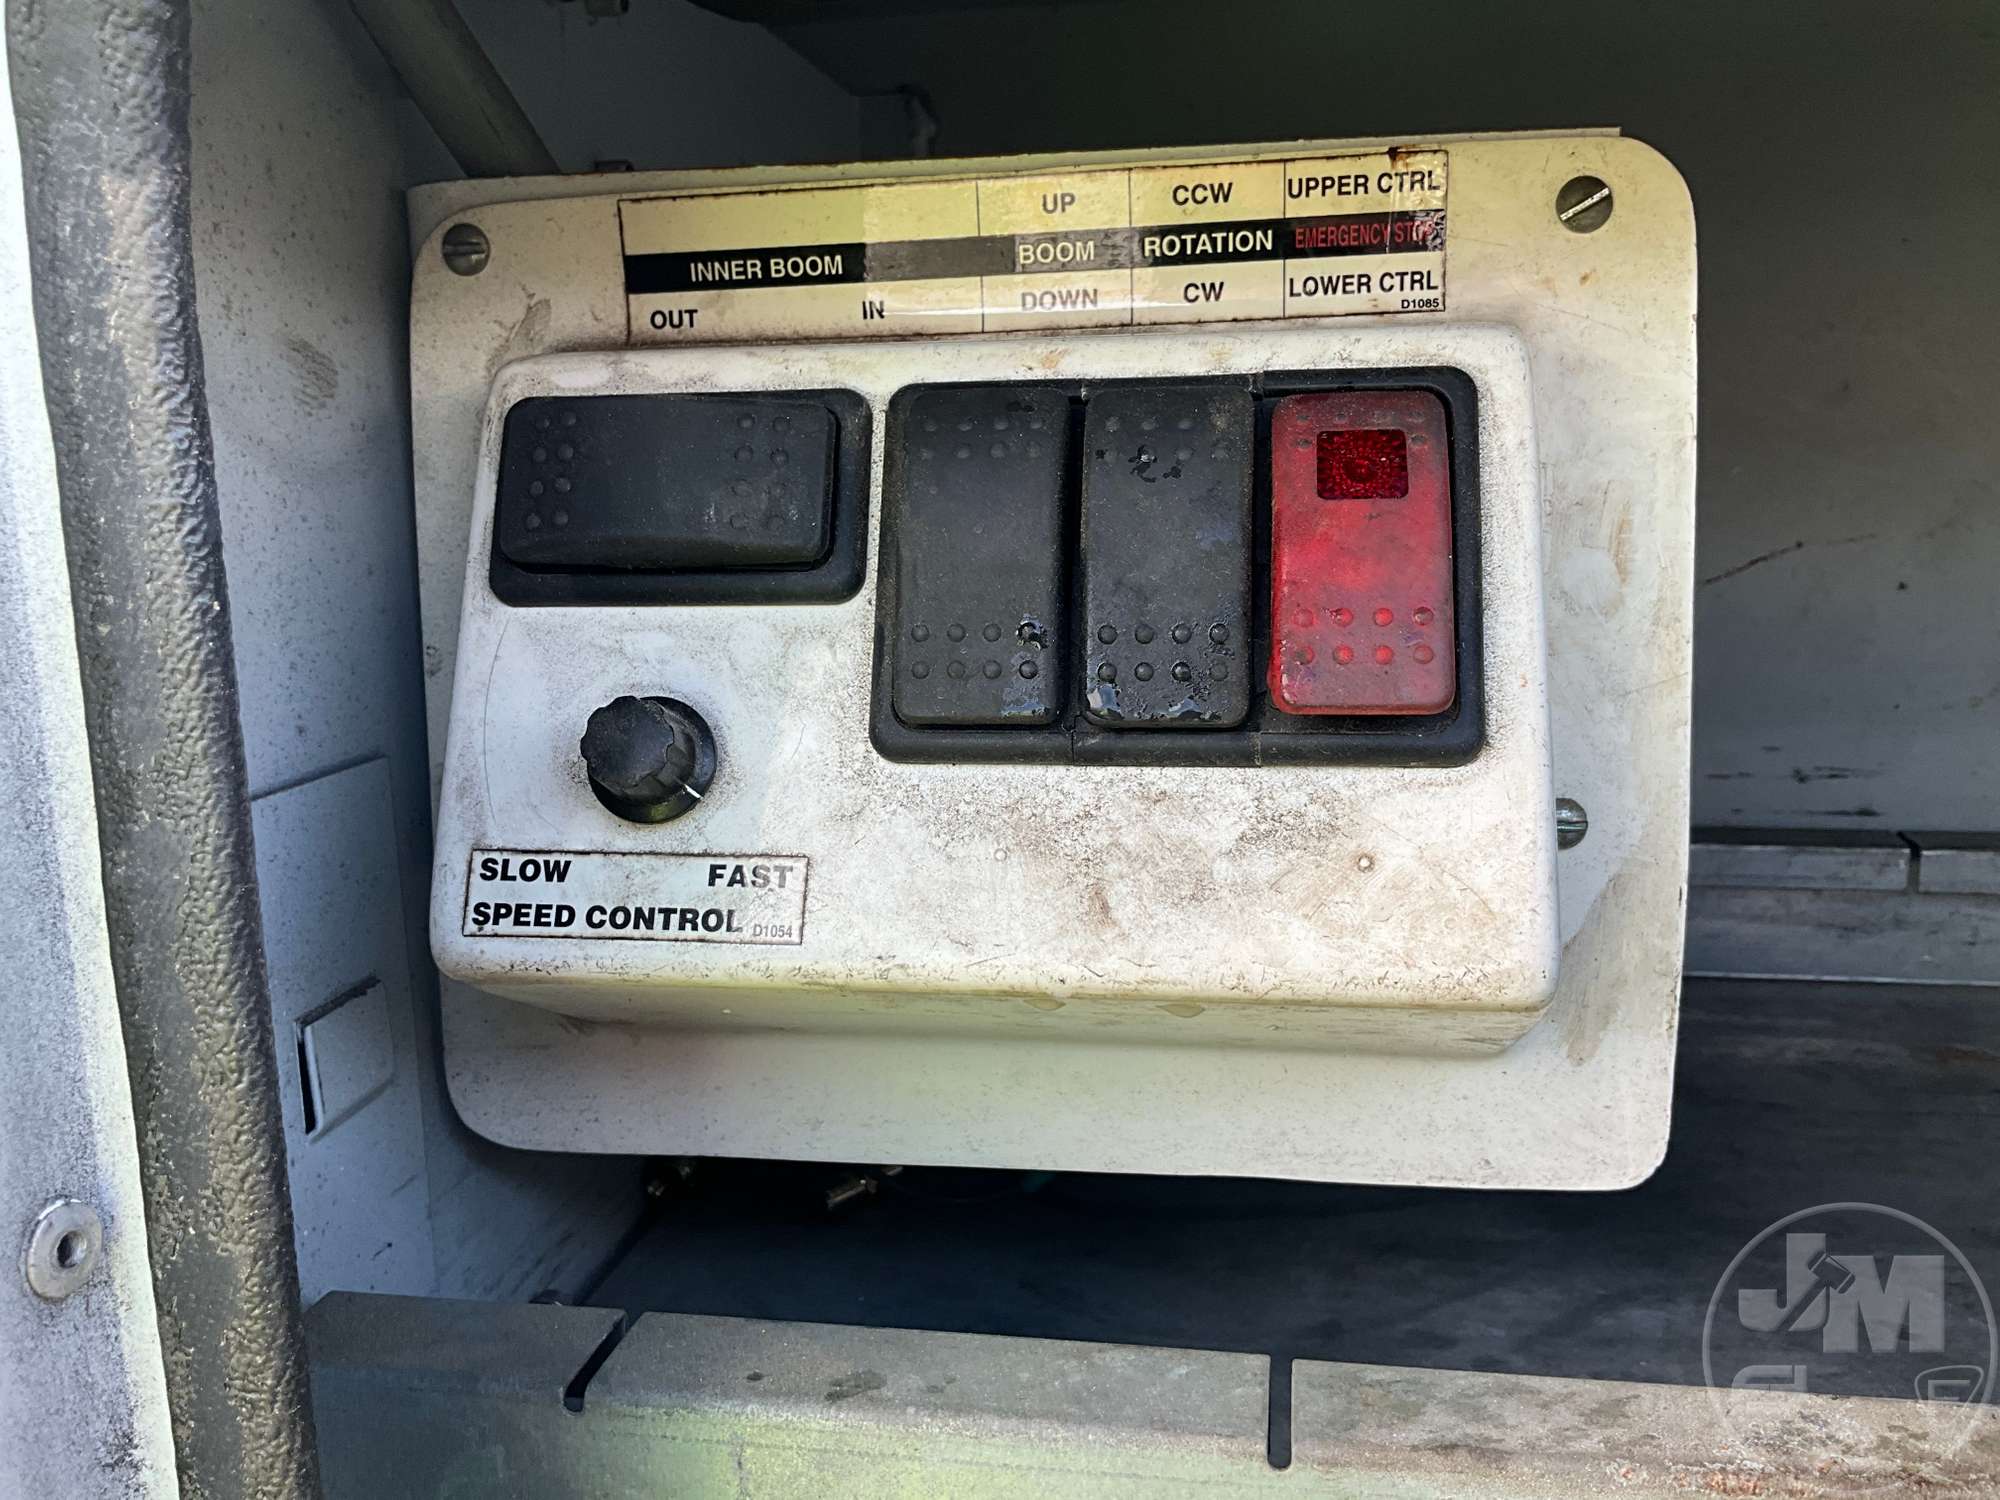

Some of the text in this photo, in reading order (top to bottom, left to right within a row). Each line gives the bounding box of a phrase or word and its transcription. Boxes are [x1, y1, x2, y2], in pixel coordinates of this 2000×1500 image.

[1172, 182, 1233, 206] CCW
[1287, 170, 1441, 199] UPPER CTRL
[1042, 193, 1076, 215] UP
[1144, 230, 1273, 257] ROTATION
[1295, 223, 1390, 249] EMERGENCY
[1019, 241, 1095, 266] BOOM
[690, 255, 843, 283] INNER BOOM
[1183, 282, 1224, 304] CW
[1289, 270, 1438, 298] LOWER CTRL
[863, 300, 884, 320] IN
[1021, 288, 1098, 312] DOWN
[1401, 297, 1440, 310] D1085
[650, 309, 698, 330] OUT
[479, 858, 572, 882] SLOW
[708, 864, 794, 889] FAST
[472, 902, 744, 933] SPEED CONTROL
[753, 924, 793, 939] D1054
